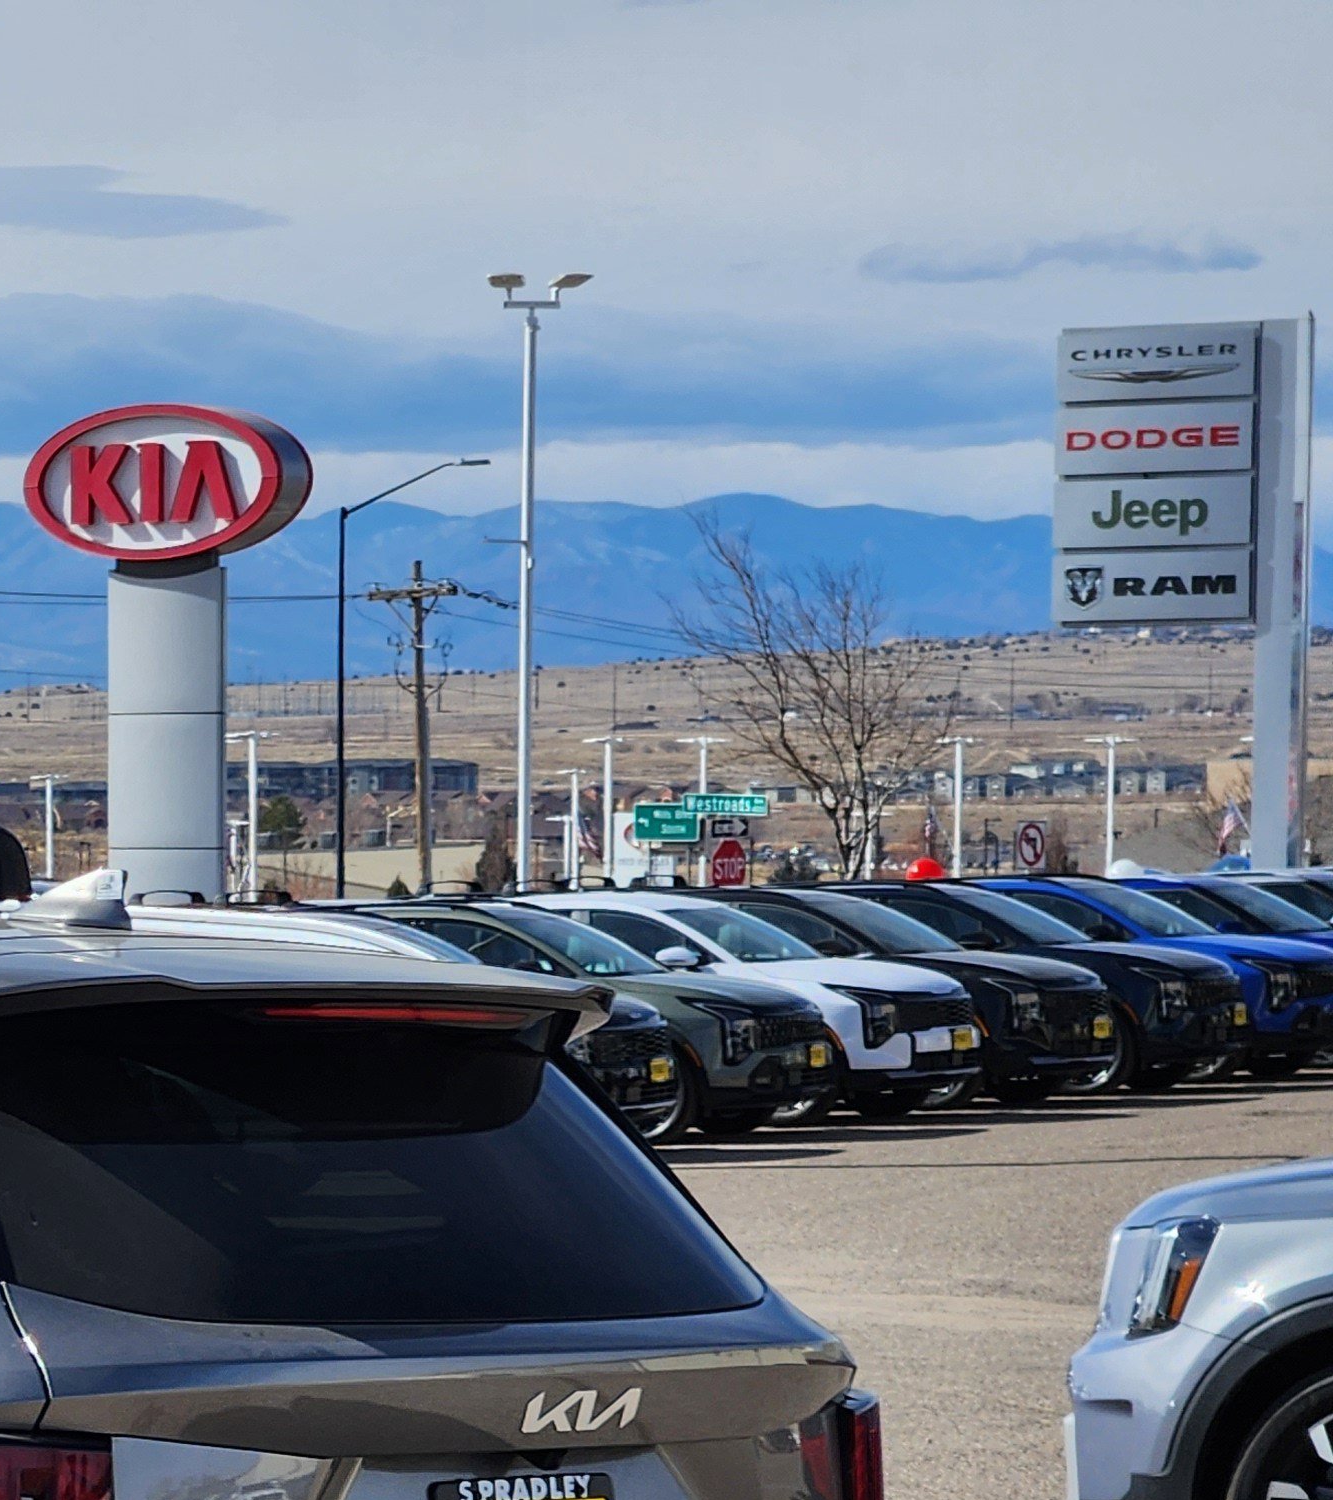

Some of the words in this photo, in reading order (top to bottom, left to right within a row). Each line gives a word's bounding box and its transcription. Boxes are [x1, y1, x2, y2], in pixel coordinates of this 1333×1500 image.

[1071, 344, 1237, 361] CHRYSLER
[1066, 426, 1240, 451] DODGE
[69, 440, 237, 525] KIA
[1092, 490, 1209, 536] Jeep
[1113, 575, 1237, 597] RAM
[686, 797, 750, 812] Westroads
[714, 857, 745, 880] STOP
[520, 1387, 643, 1434] KIA
